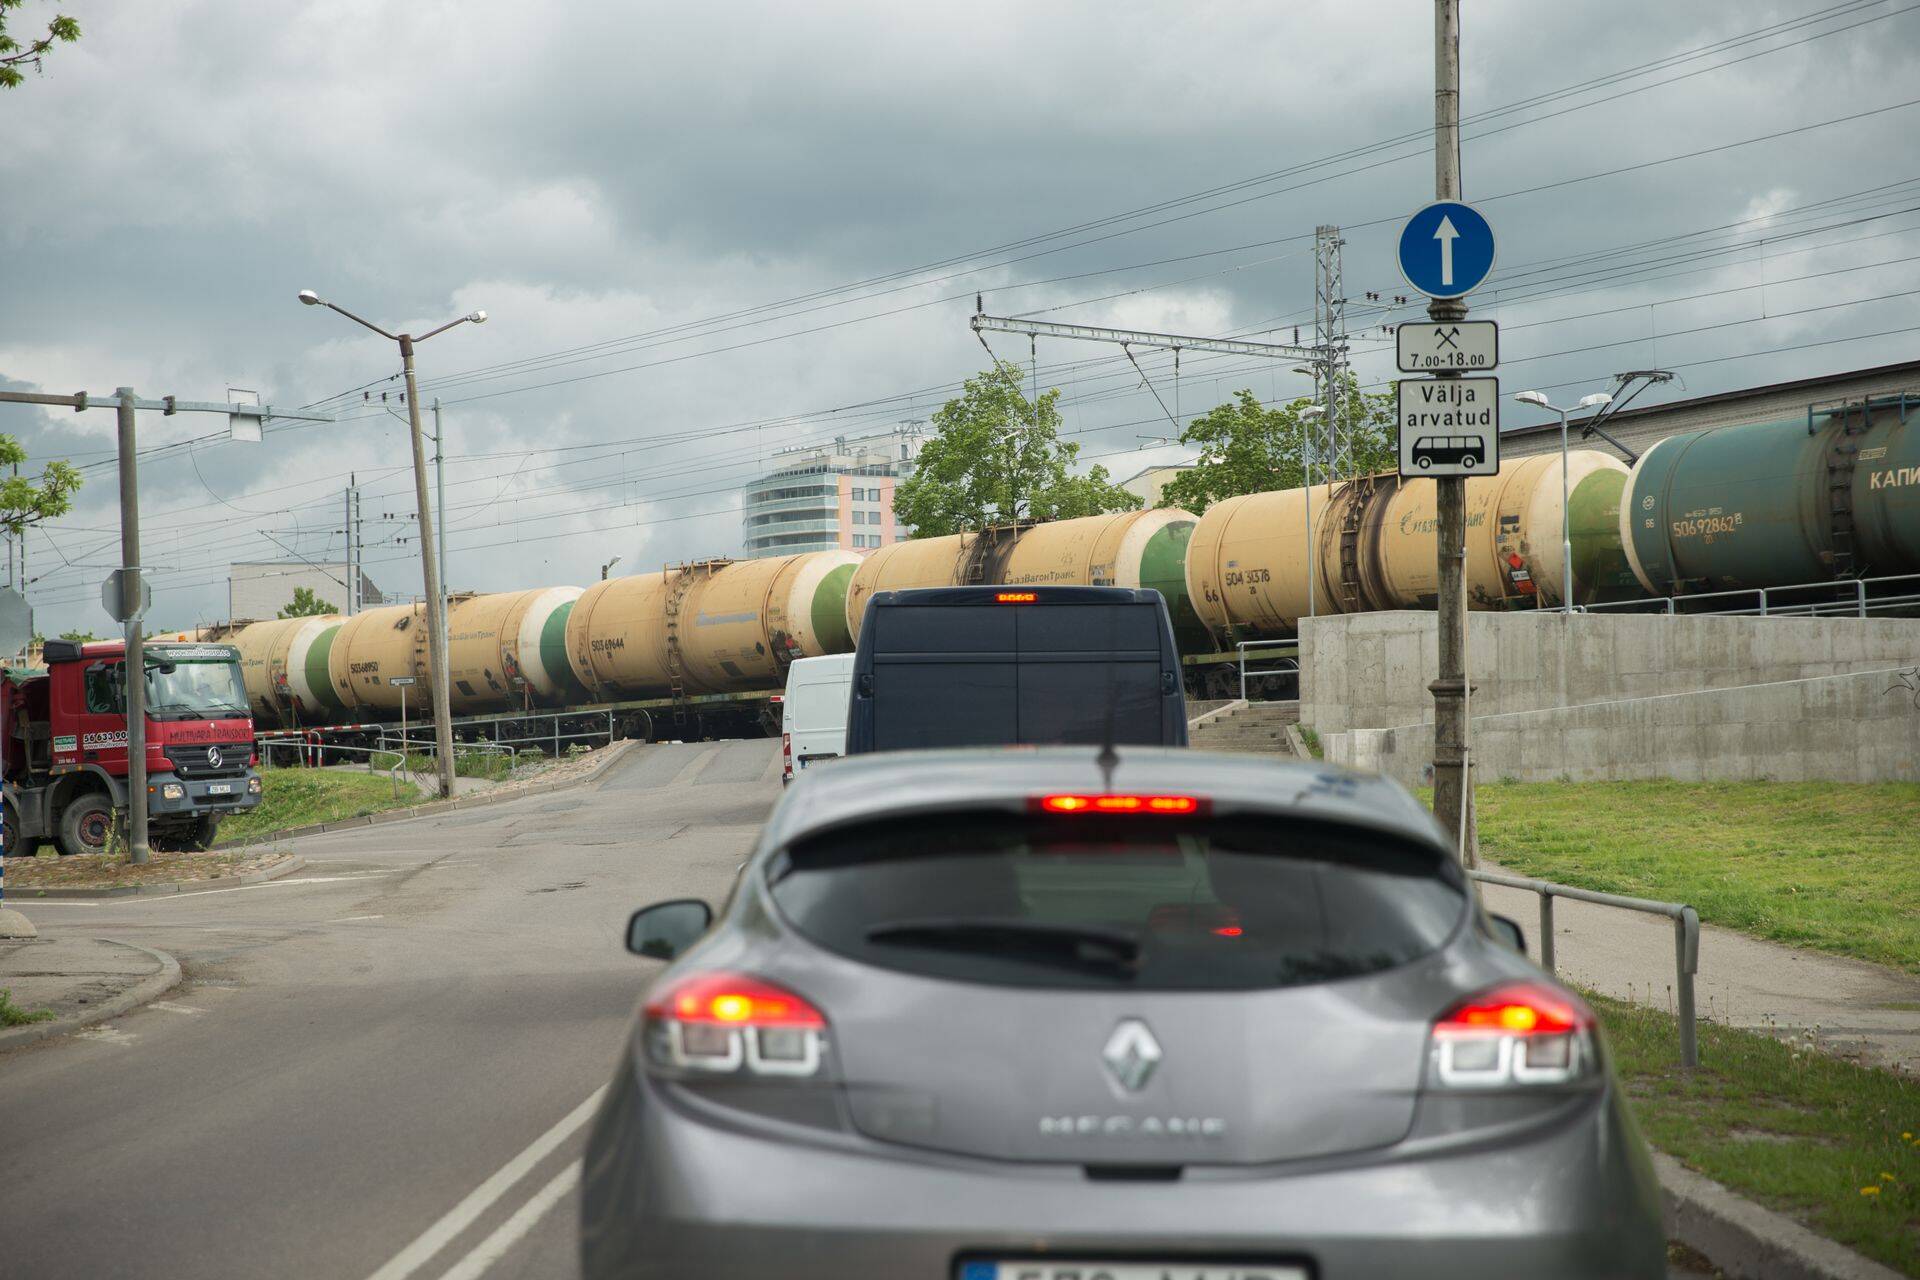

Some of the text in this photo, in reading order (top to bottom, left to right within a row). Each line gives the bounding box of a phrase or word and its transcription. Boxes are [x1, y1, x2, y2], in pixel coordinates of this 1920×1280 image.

[1410, 352, 1485, 367] 7.00-18.00
[1421, 385, 1475, 406] Välja
[1407, 408, 1490, 427] arvatud
[1672, 516, 1735, 537] 50692862
[1205, 589, 1219, 602] 66
[83, 733, 96, 743] 56
[114, 729, 128, 740] 90
